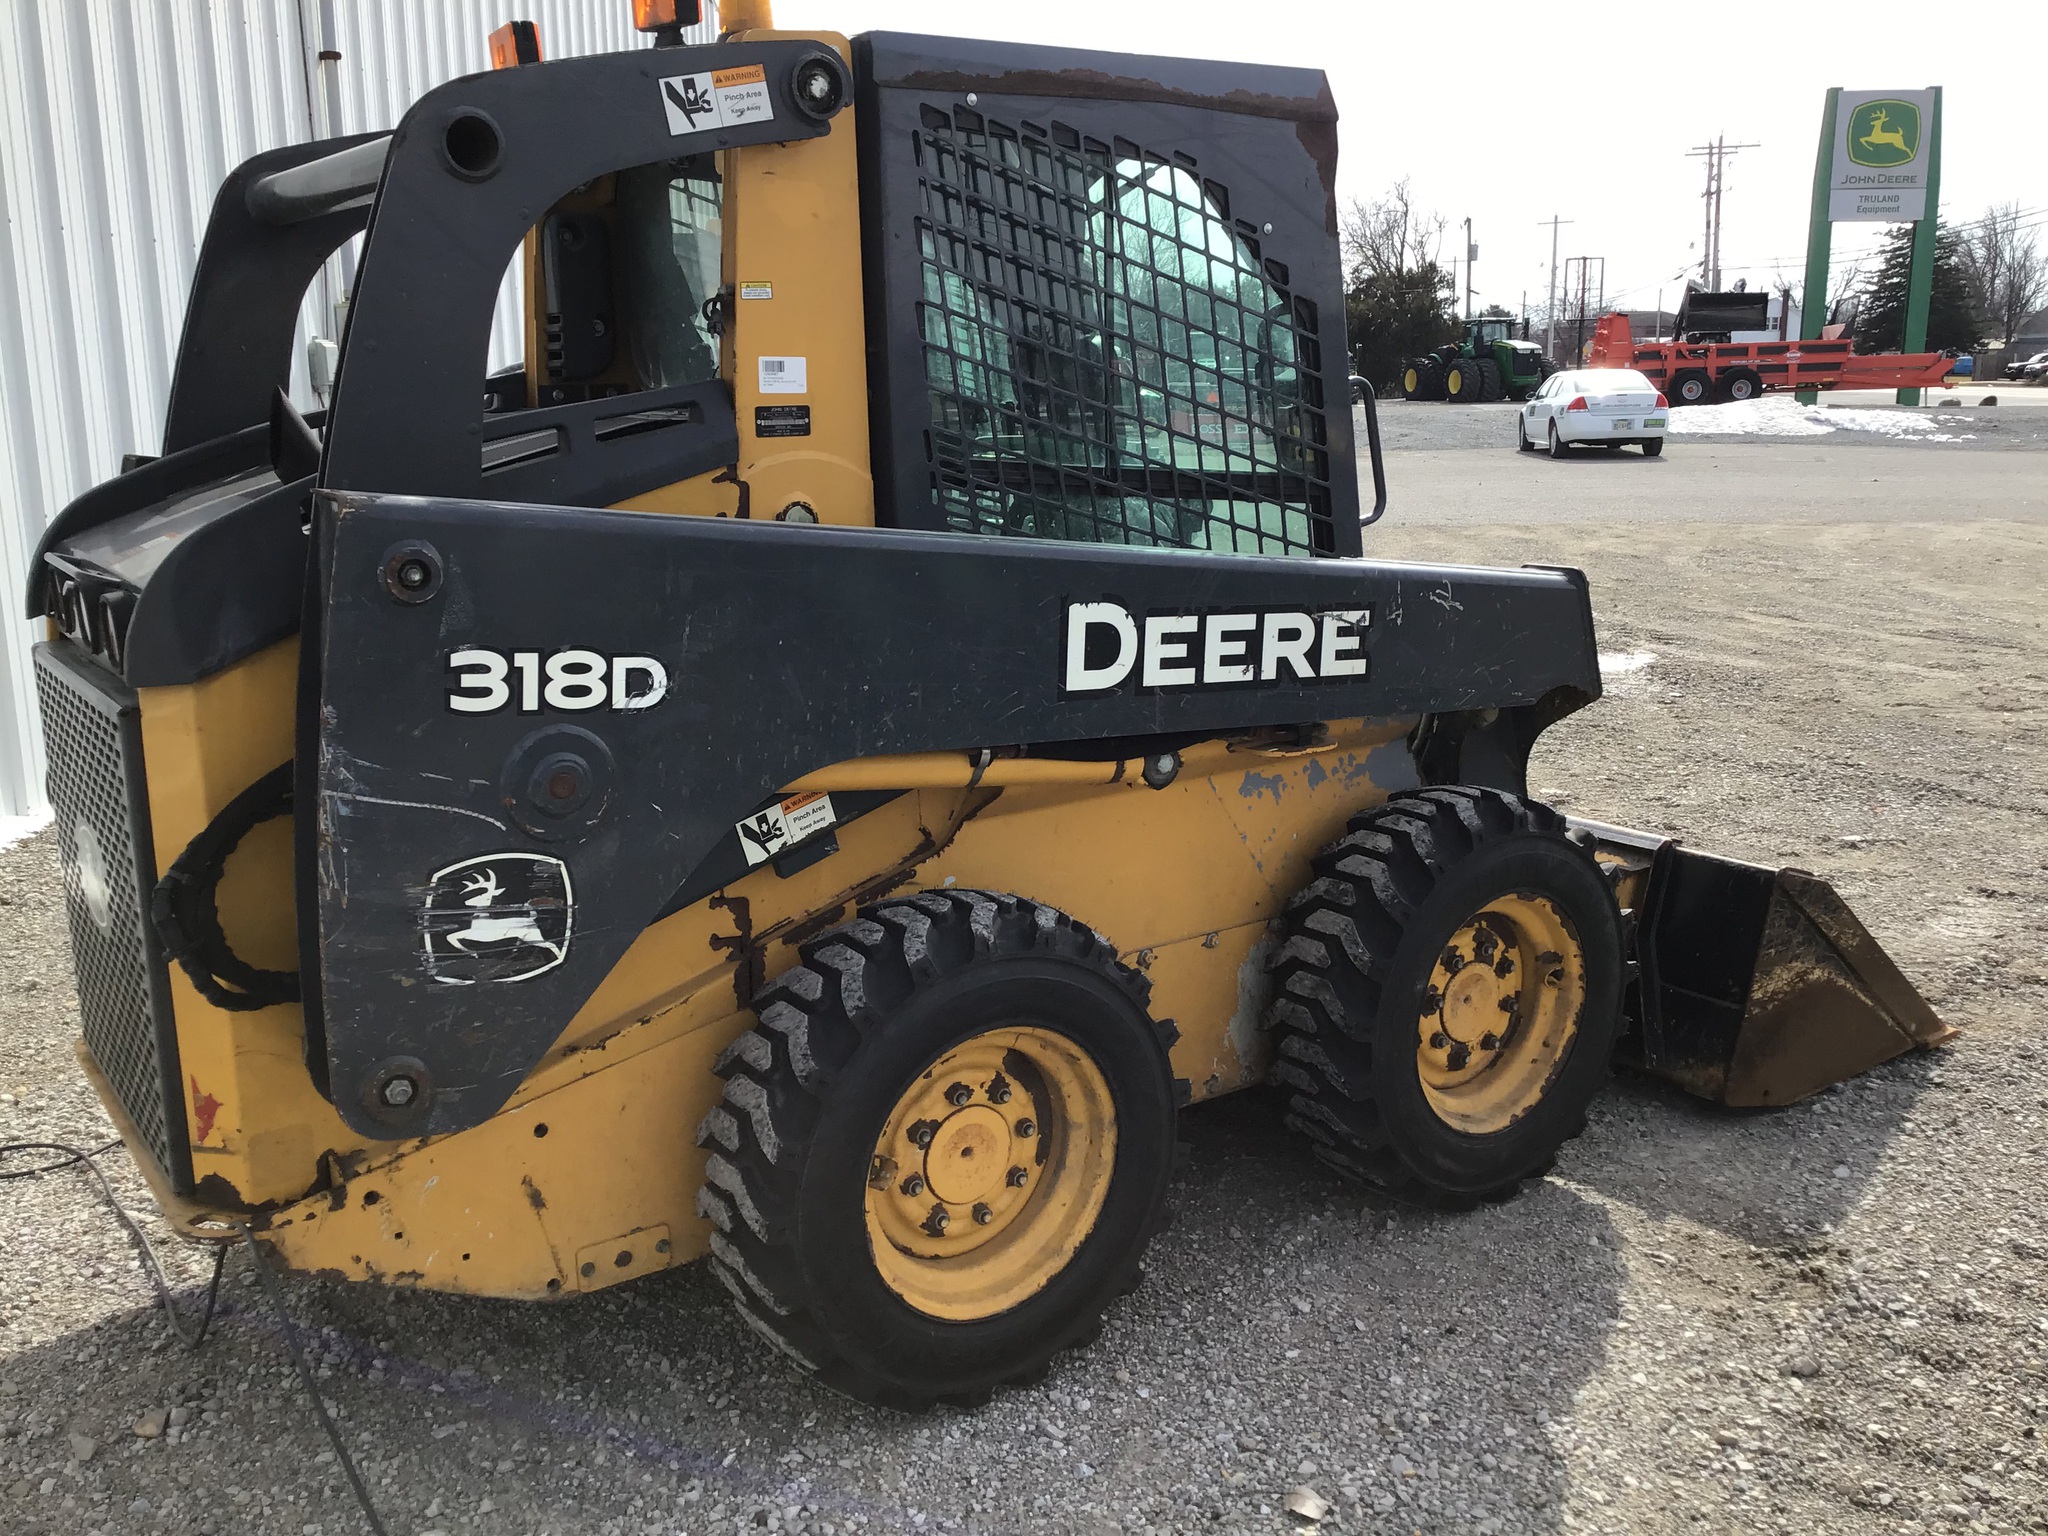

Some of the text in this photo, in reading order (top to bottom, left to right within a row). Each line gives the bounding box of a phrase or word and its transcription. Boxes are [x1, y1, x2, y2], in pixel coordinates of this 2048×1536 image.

[722, 70, 761, 83] WARNING
[724, 91, 762, 102] Pinch Area
[731, 107, 745, 115] Keep
[1840, 174, 1918, 184] JOHN DEERE
[1858, 195, 1900, 203] TRULAND
[1856, 205, 1900, 214] Equipment
[1066, 602, 1370, 691] DEERE
[450, 649, 668, 712] 318D
[793, 804, 826, 823] Pinch Area
[799, 817, 826, 831] Keep Away
